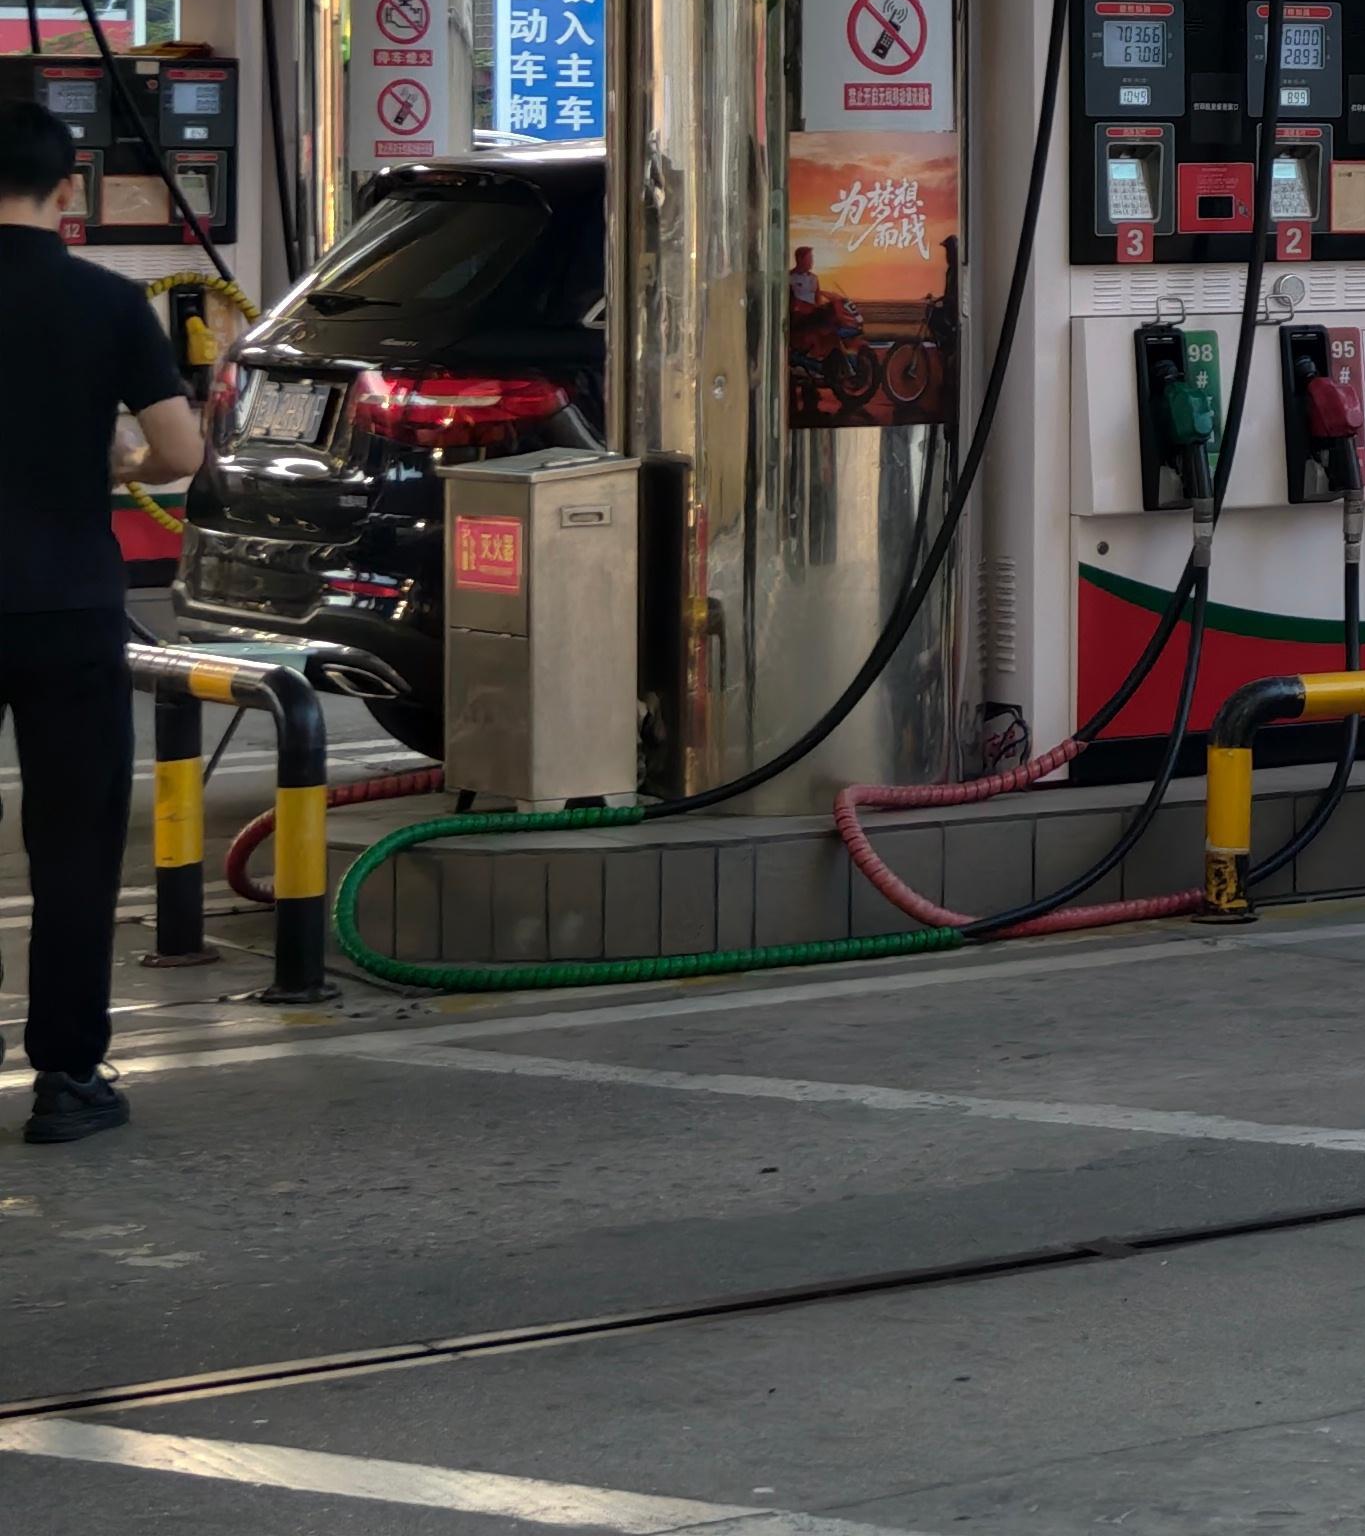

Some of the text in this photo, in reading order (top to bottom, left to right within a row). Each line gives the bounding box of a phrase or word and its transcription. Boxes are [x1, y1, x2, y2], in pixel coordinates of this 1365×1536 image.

[1126, 229, 1144, 256] 3
[1285, 228, 1302, 254] 2
[481, 533, 514, 562] 灭火器
